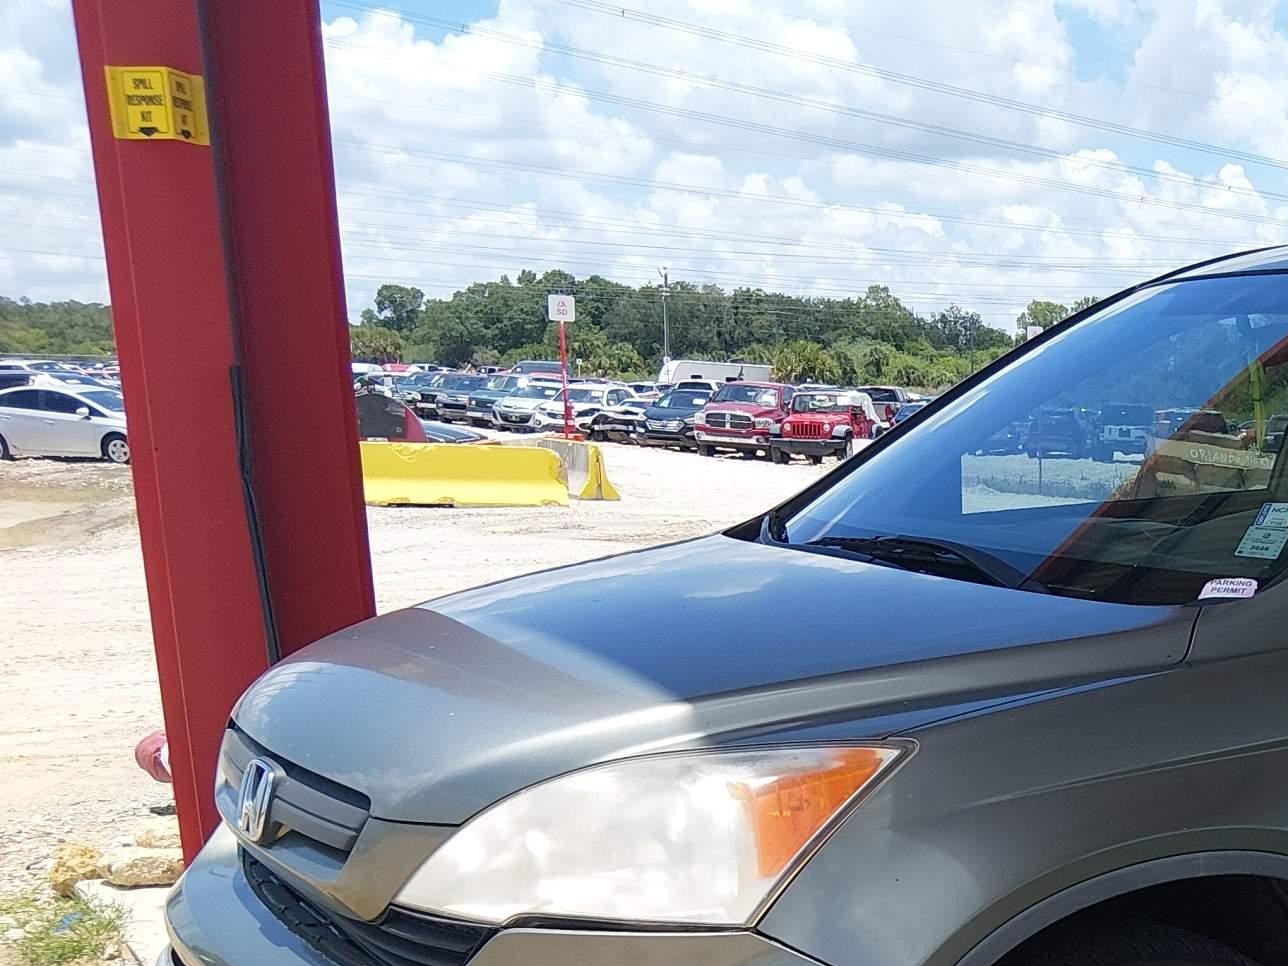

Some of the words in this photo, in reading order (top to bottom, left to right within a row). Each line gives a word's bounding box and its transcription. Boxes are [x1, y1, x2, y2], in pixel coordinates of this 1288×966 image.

[132, 78, 154, 90] SPILL
[127, 94, 164, 106] RESPONSE
[140, 111, 153, 122] KIT
[1210, 578, 1253, 587] PARKING
